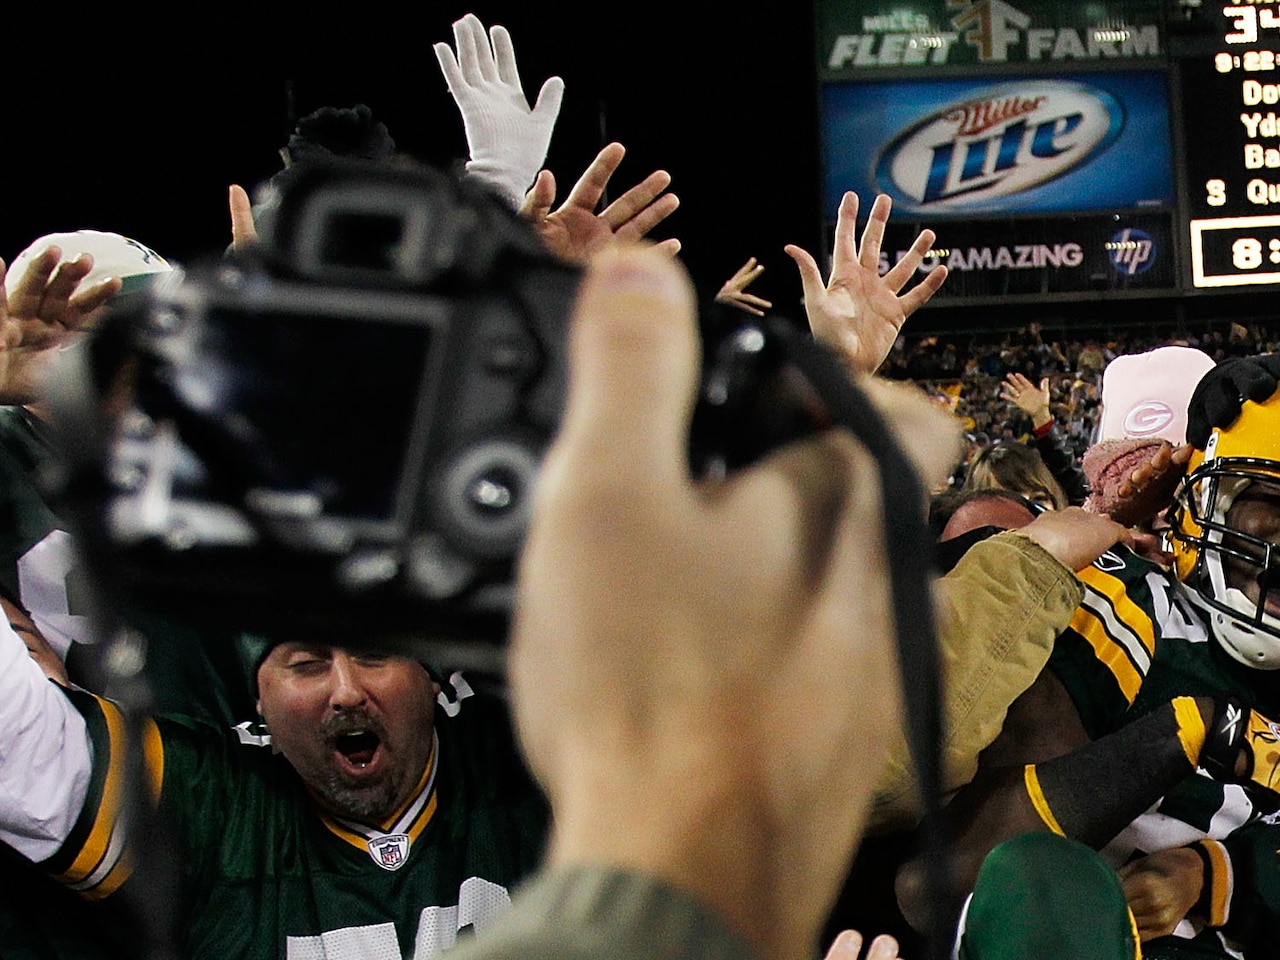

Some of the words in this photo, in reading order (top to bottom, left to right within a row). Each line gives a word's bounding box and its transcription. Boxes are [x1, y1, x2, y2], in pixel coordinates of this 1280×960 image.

[828, 32, 958, 68] FLEET
[1026, 25, 1159, 59] FARM
[941, 96, 1047, 136] Miller
[921, 111, 1083, 204] Lite
[947, 243, 1084, 270] AMAZING
